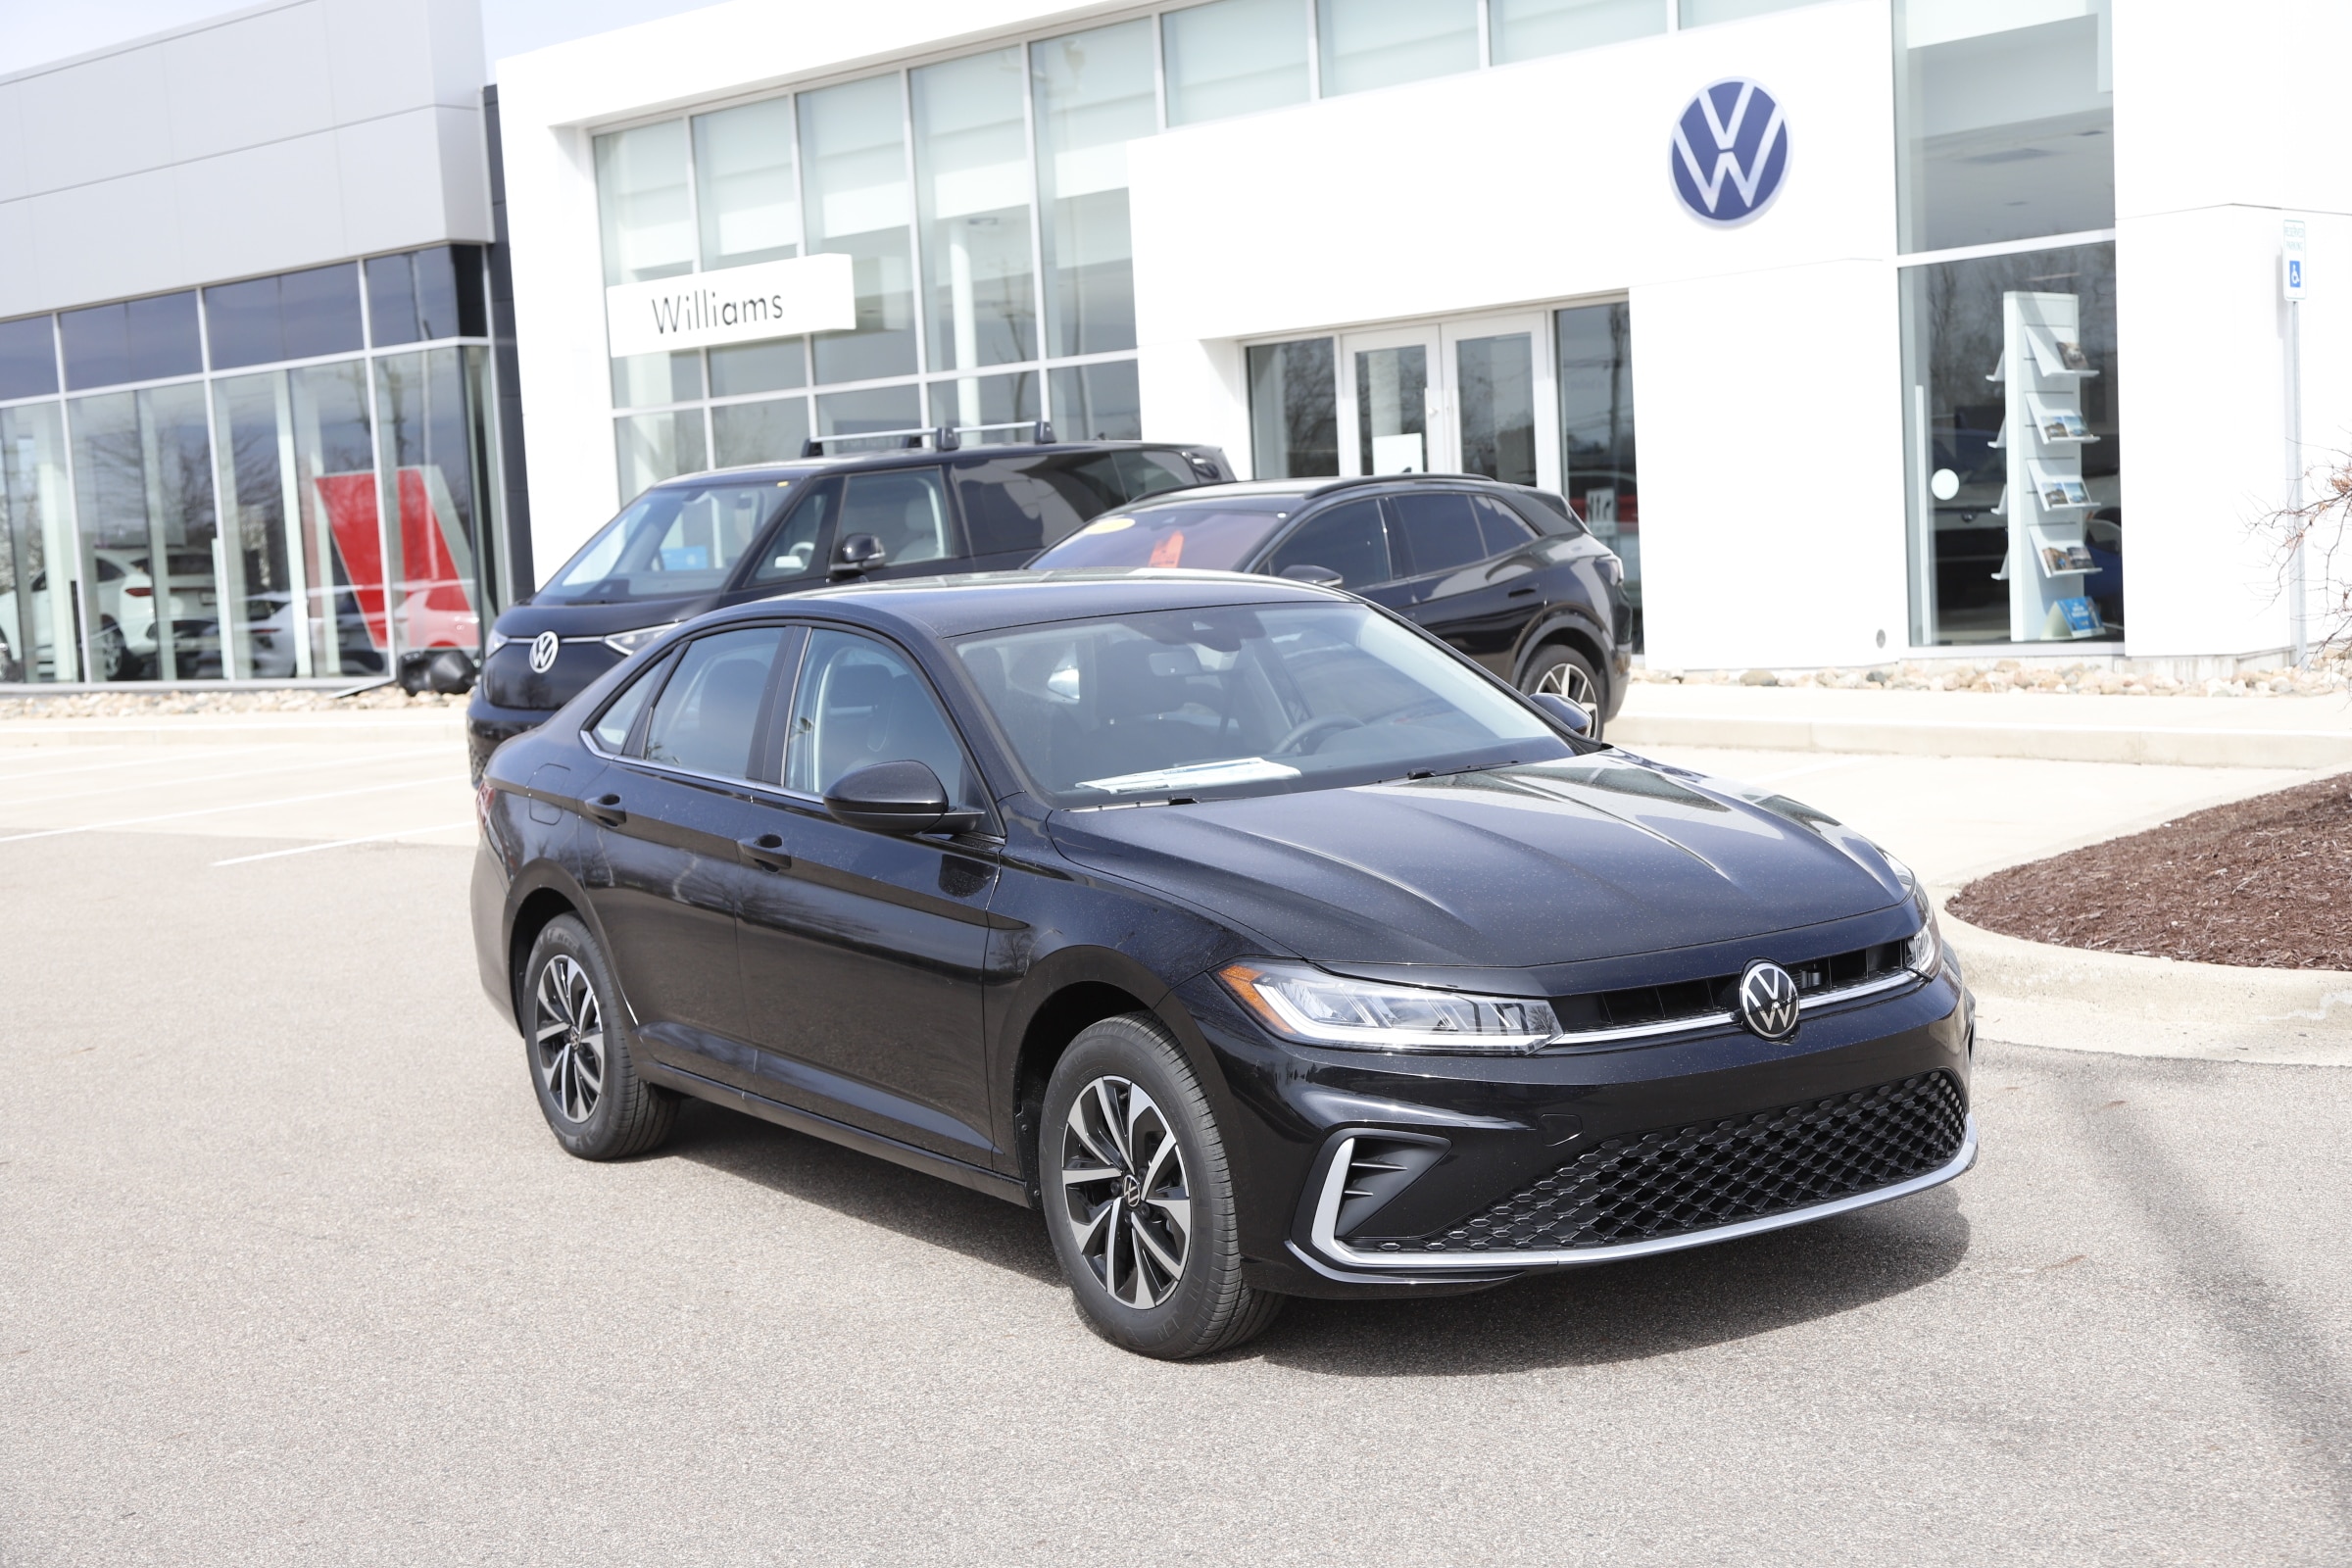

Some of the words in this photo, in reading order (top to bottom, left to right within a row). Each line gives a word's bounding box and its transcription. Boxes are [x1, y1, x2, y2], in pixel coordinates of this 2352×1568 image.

[1670, 78, 1790, 223] VW
[652, 289, 783, 334] Williams
[530, 631, 559, 673] VW
[1742, 962, 1798, 1038] VW
